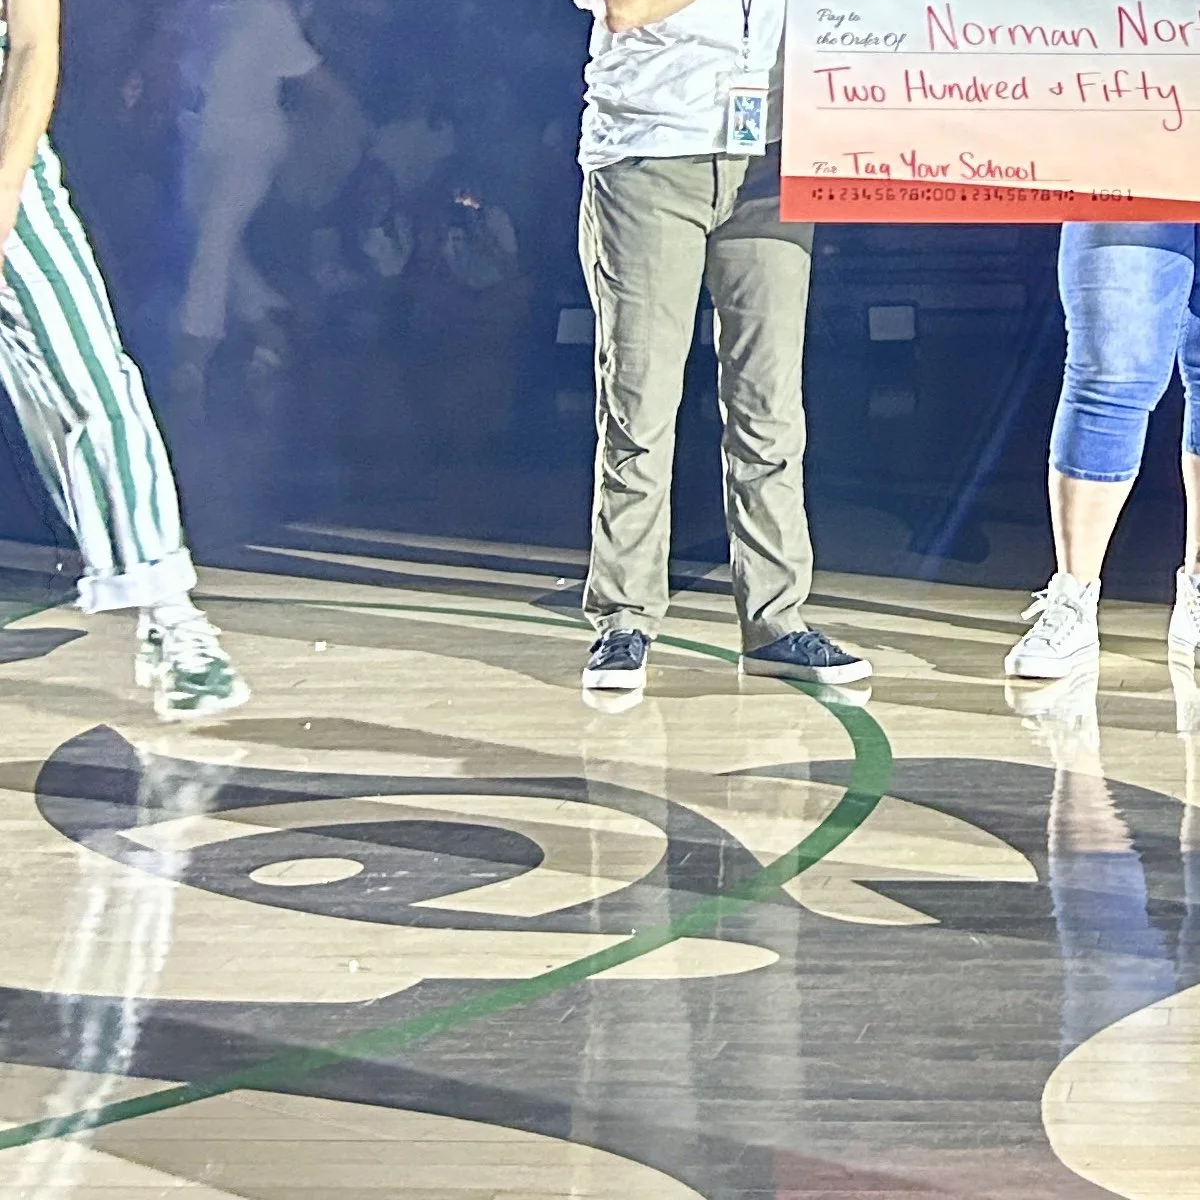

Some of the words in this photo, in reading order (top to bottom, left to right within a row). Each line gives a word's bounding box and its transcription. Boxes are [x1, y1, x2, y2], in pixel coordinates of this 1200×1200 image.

[816, 8, 848, 27] Pay
[848, 11, 861, 22] to
[926, 3, 1099, 51] Norman
[816, 32, 838, 46] the
[840, 31, 880, 47] Order
[883, 31, 909, 52] Of
[813, 66, 886, 103] Two
[904, 69, 1029, 103] Hundred
[1076, 70, 1183, 132] Fifty
[812, 161, 838, 175] For
[842, 151, 892, 180] Tag
[900, 150, 951, 179] Your
[959, 152, 1038, 181] School
